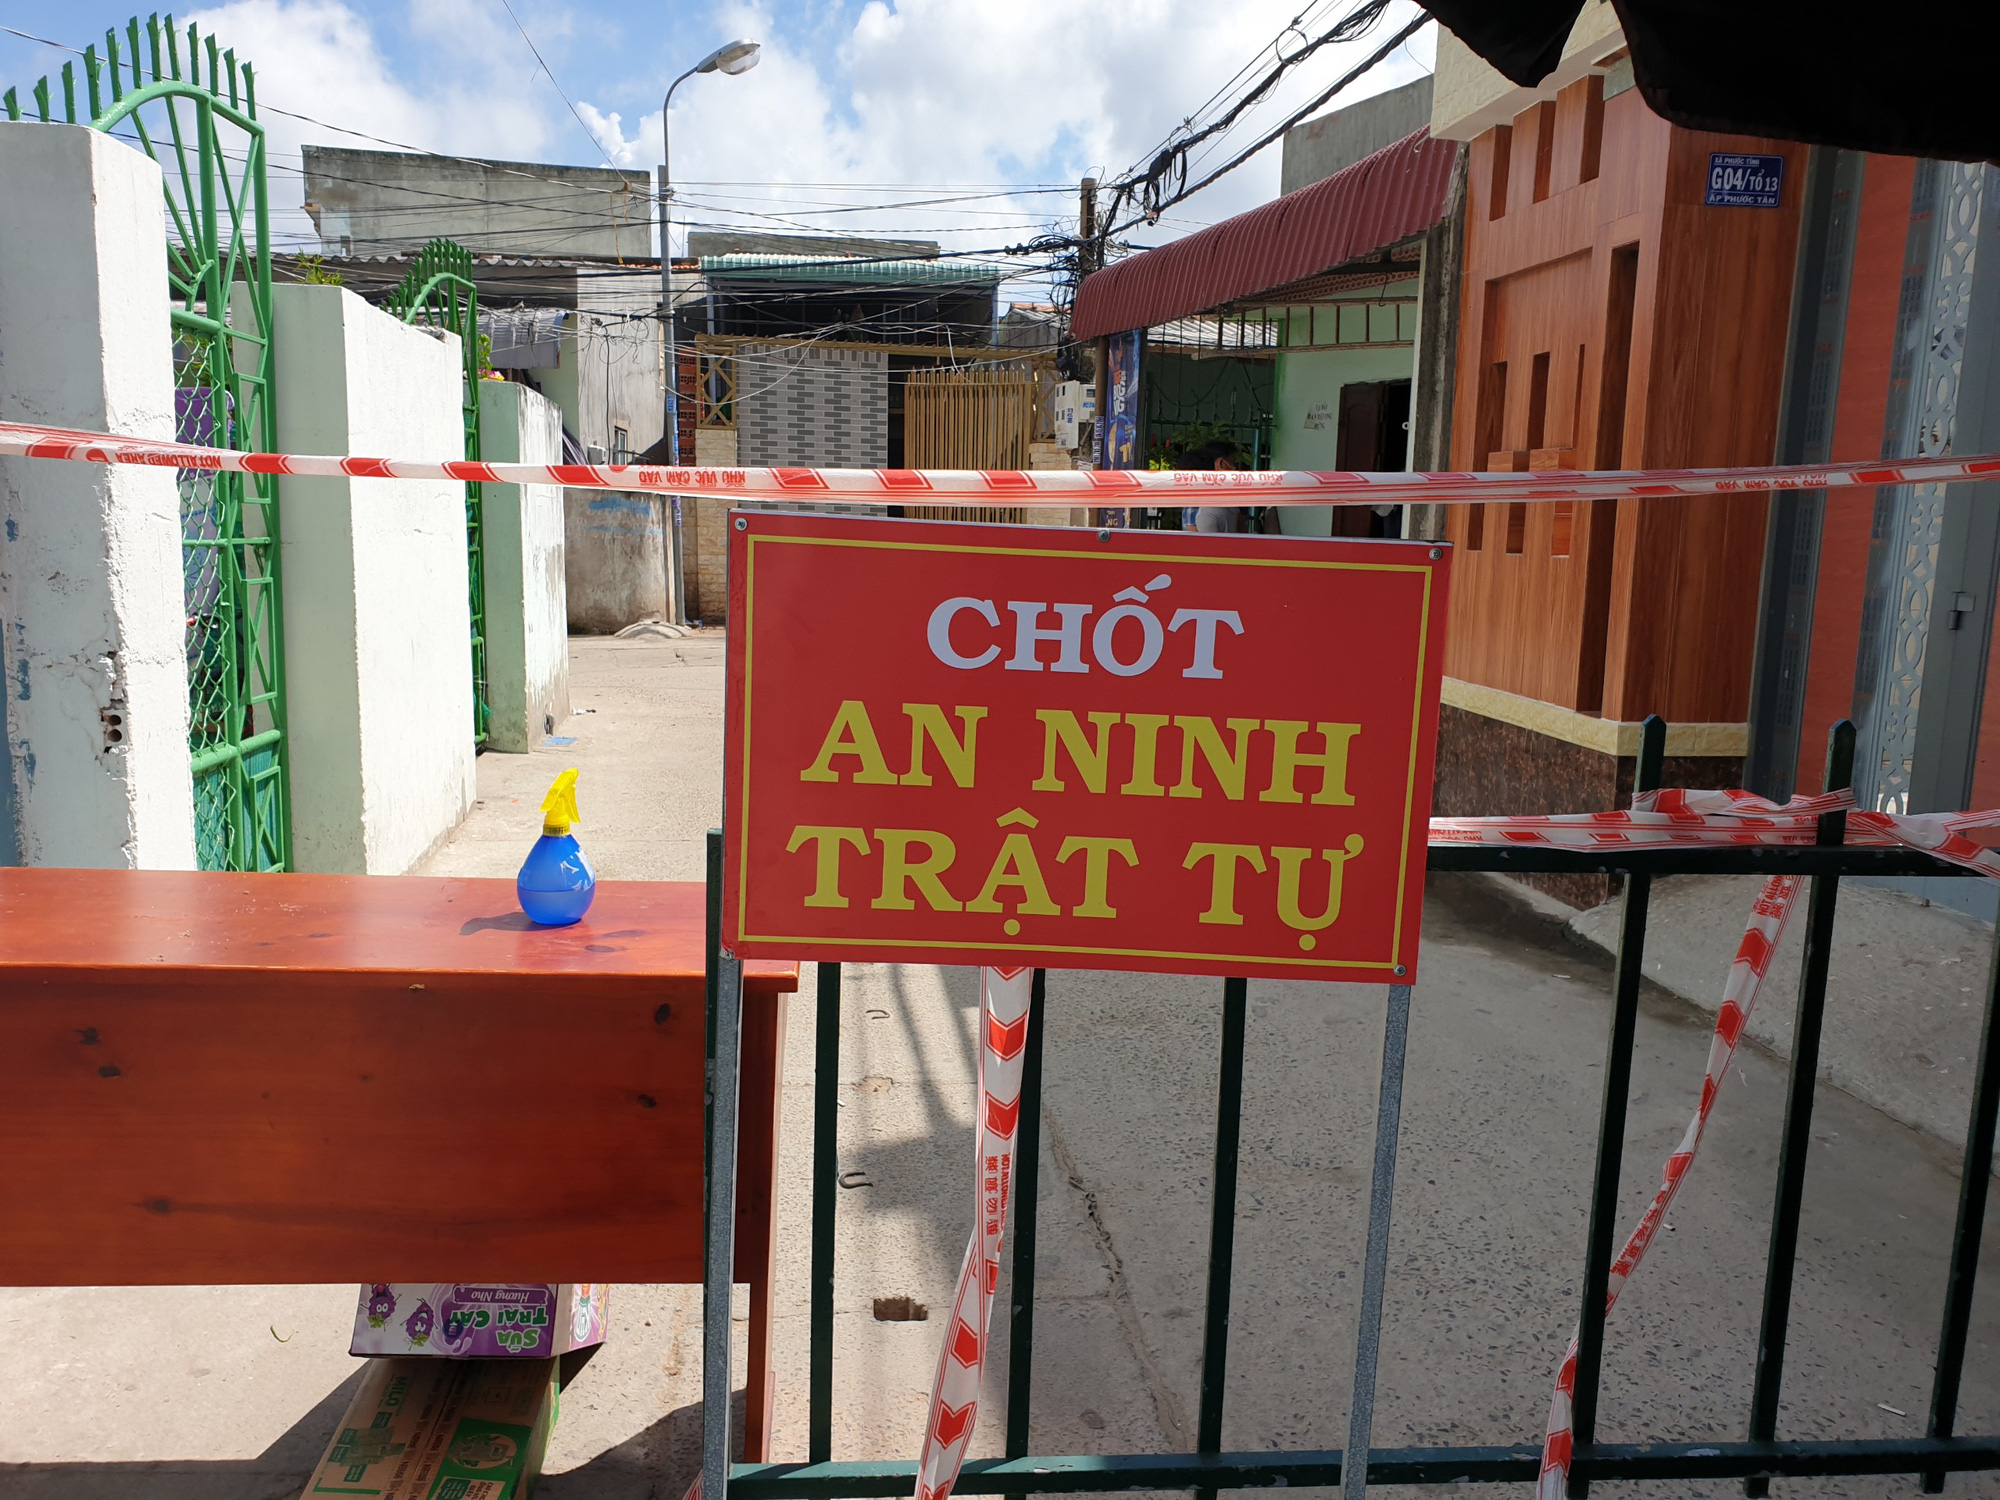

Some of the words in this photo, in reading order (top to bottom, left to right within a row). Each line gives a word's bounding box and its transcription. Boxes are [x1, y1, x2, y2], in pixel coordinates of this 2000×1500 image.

[114, 452, 145, 464] AREA
[200, 456, 222, 469] NOT
[927, 573, 1245, 680] CHỐT
[800, 699, 988, 789] AN
[1032, 708, 1362, 806] NINH
[785, 806, 1140, 936] TRẬT
[1182, 832, 1365, 951] TỰ
[1757, 899, 1772, 916] NOT
[471, 1290, 492, 1302] Nho
[497, 1306, 549, 1327] TRÁI
[496, 1328, 540, 1353] SỮA
